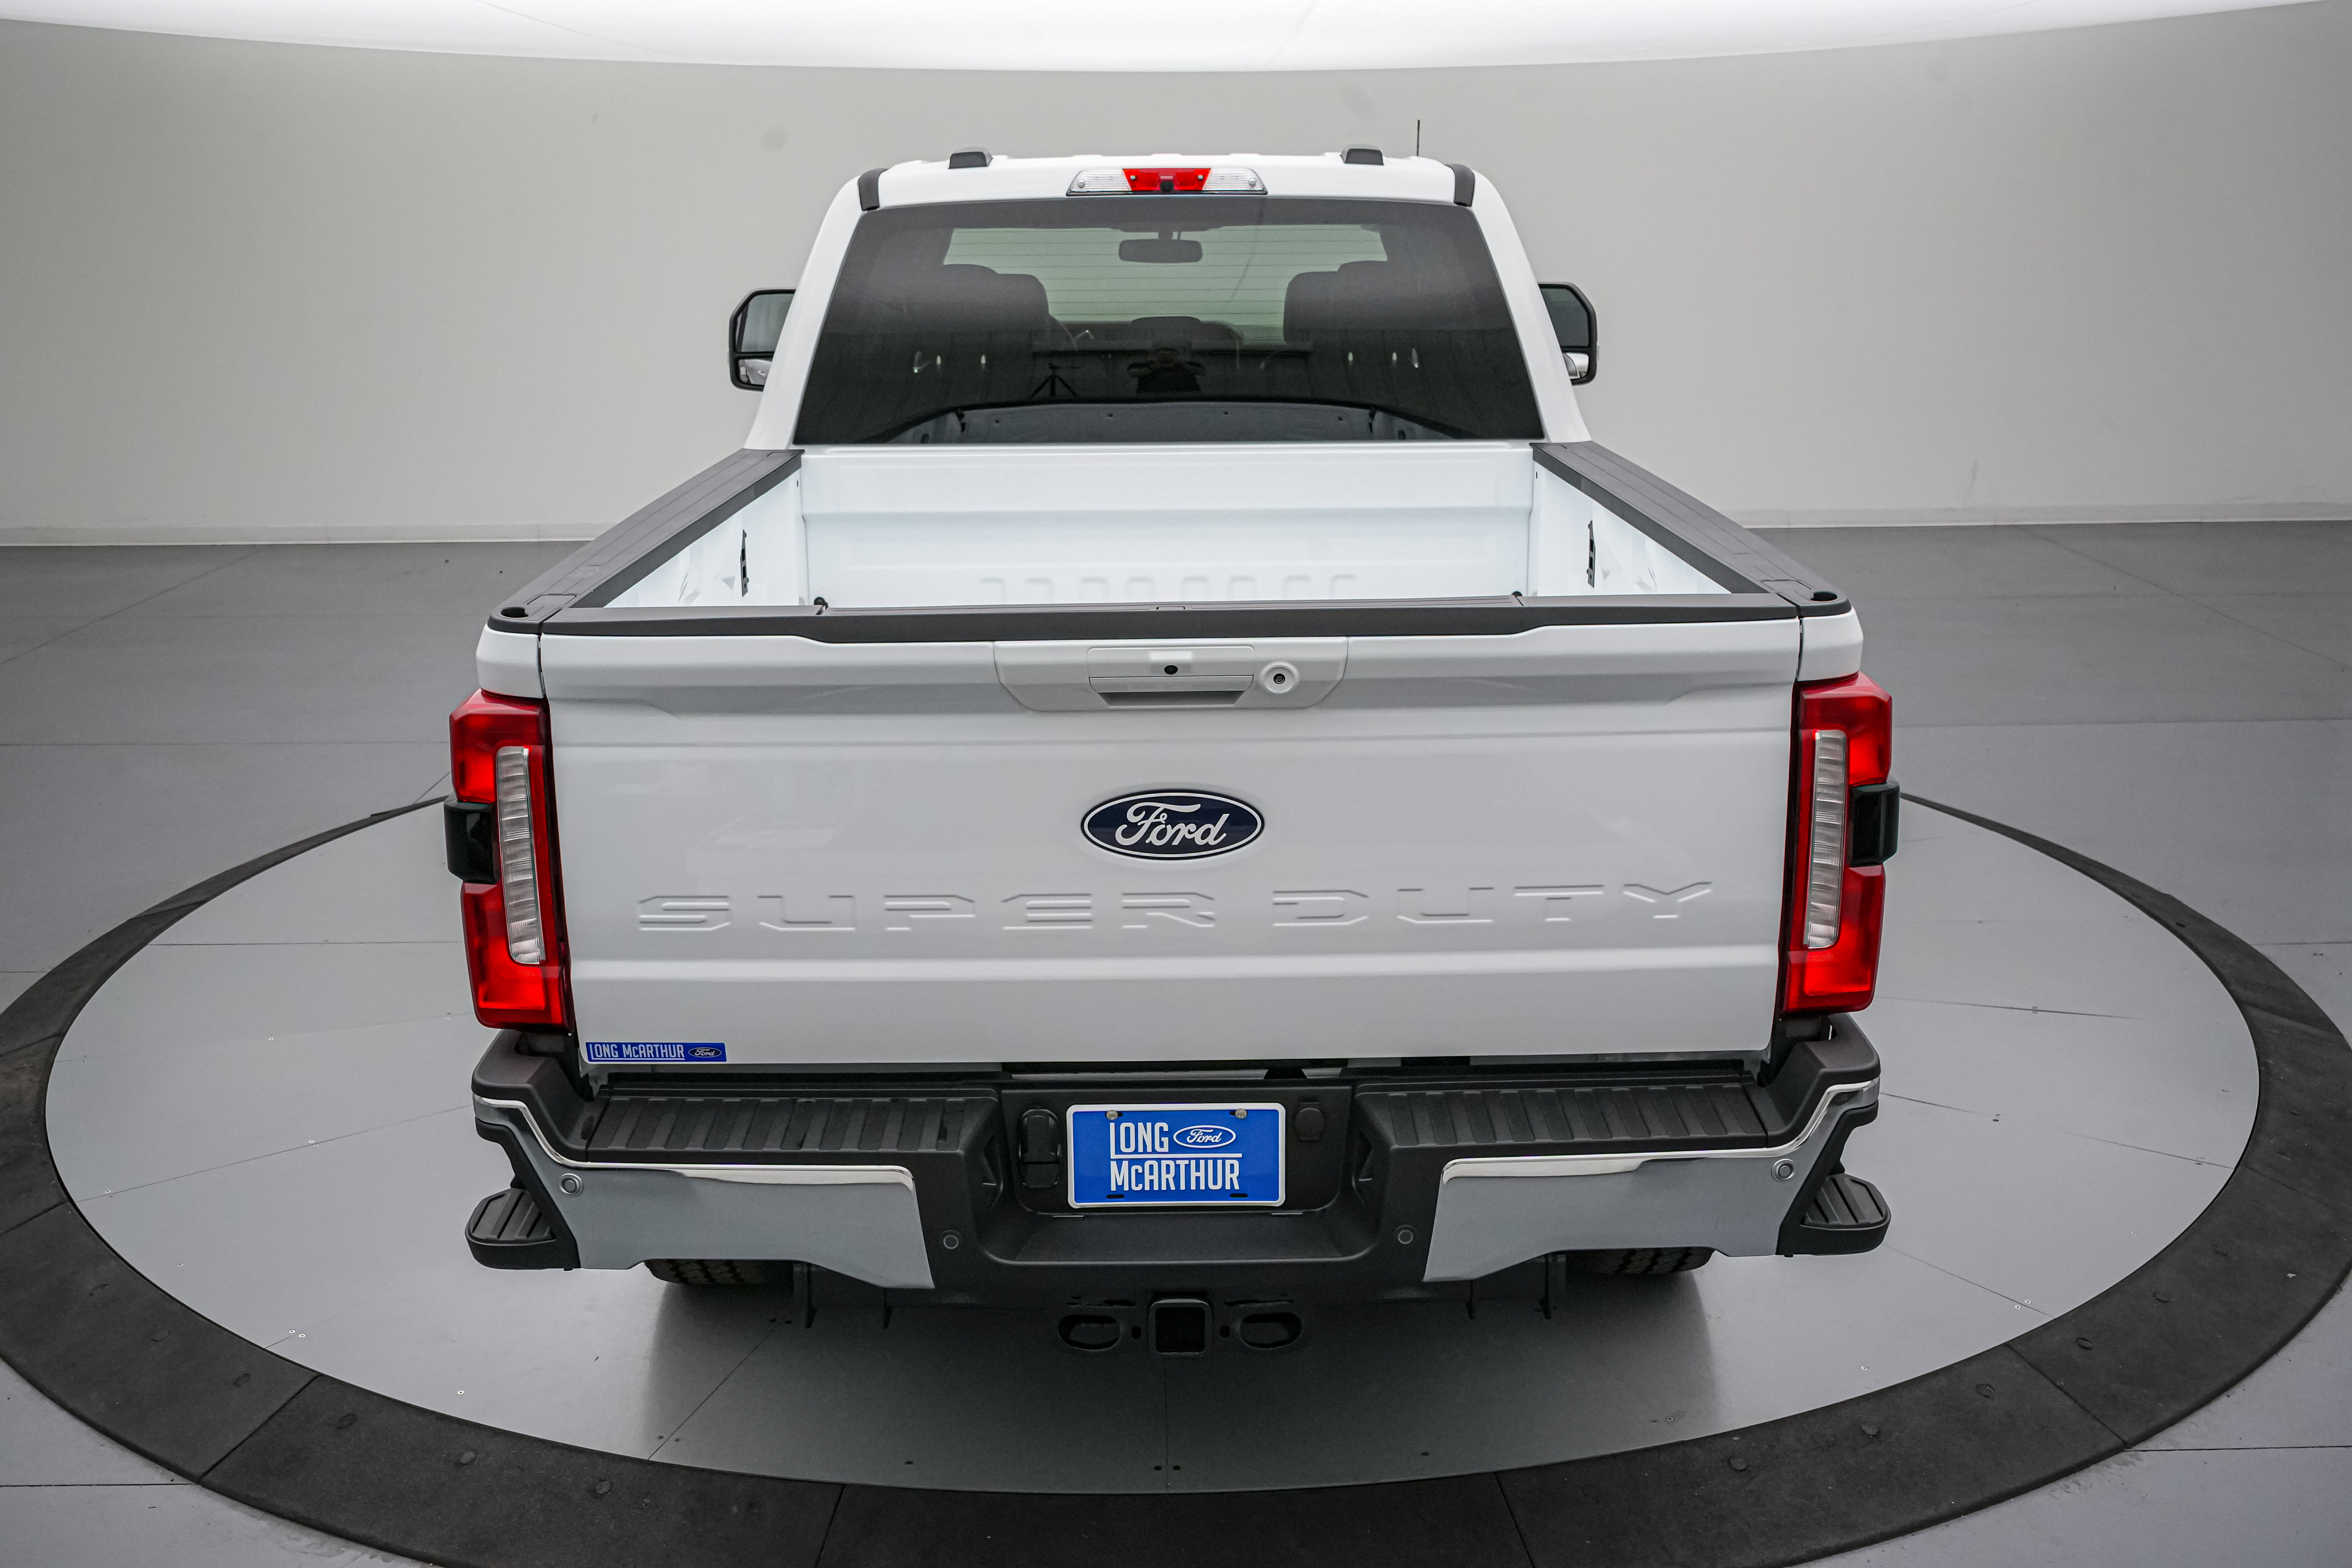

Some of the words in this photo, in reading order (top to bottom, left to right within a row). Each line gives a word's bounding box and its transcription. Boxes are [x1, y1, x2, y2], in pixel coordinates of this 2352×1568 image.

[1115, 802, 1230, 846] Ford
[637, 892, 1215, 931] SUPER
[1272, 882, 1712, 927] DUTY
[589, 1044, 619, 1060] LONG
[622, 1044, 685, 1058] McARTHUR
[694, 1048, 715, 1057] Ford
[1109, 1122, 1169, 1158] LONG
[1186, 1129, 1222, 1143] Ford
[1110, 1159, 1240, 1191] McARTHUR
